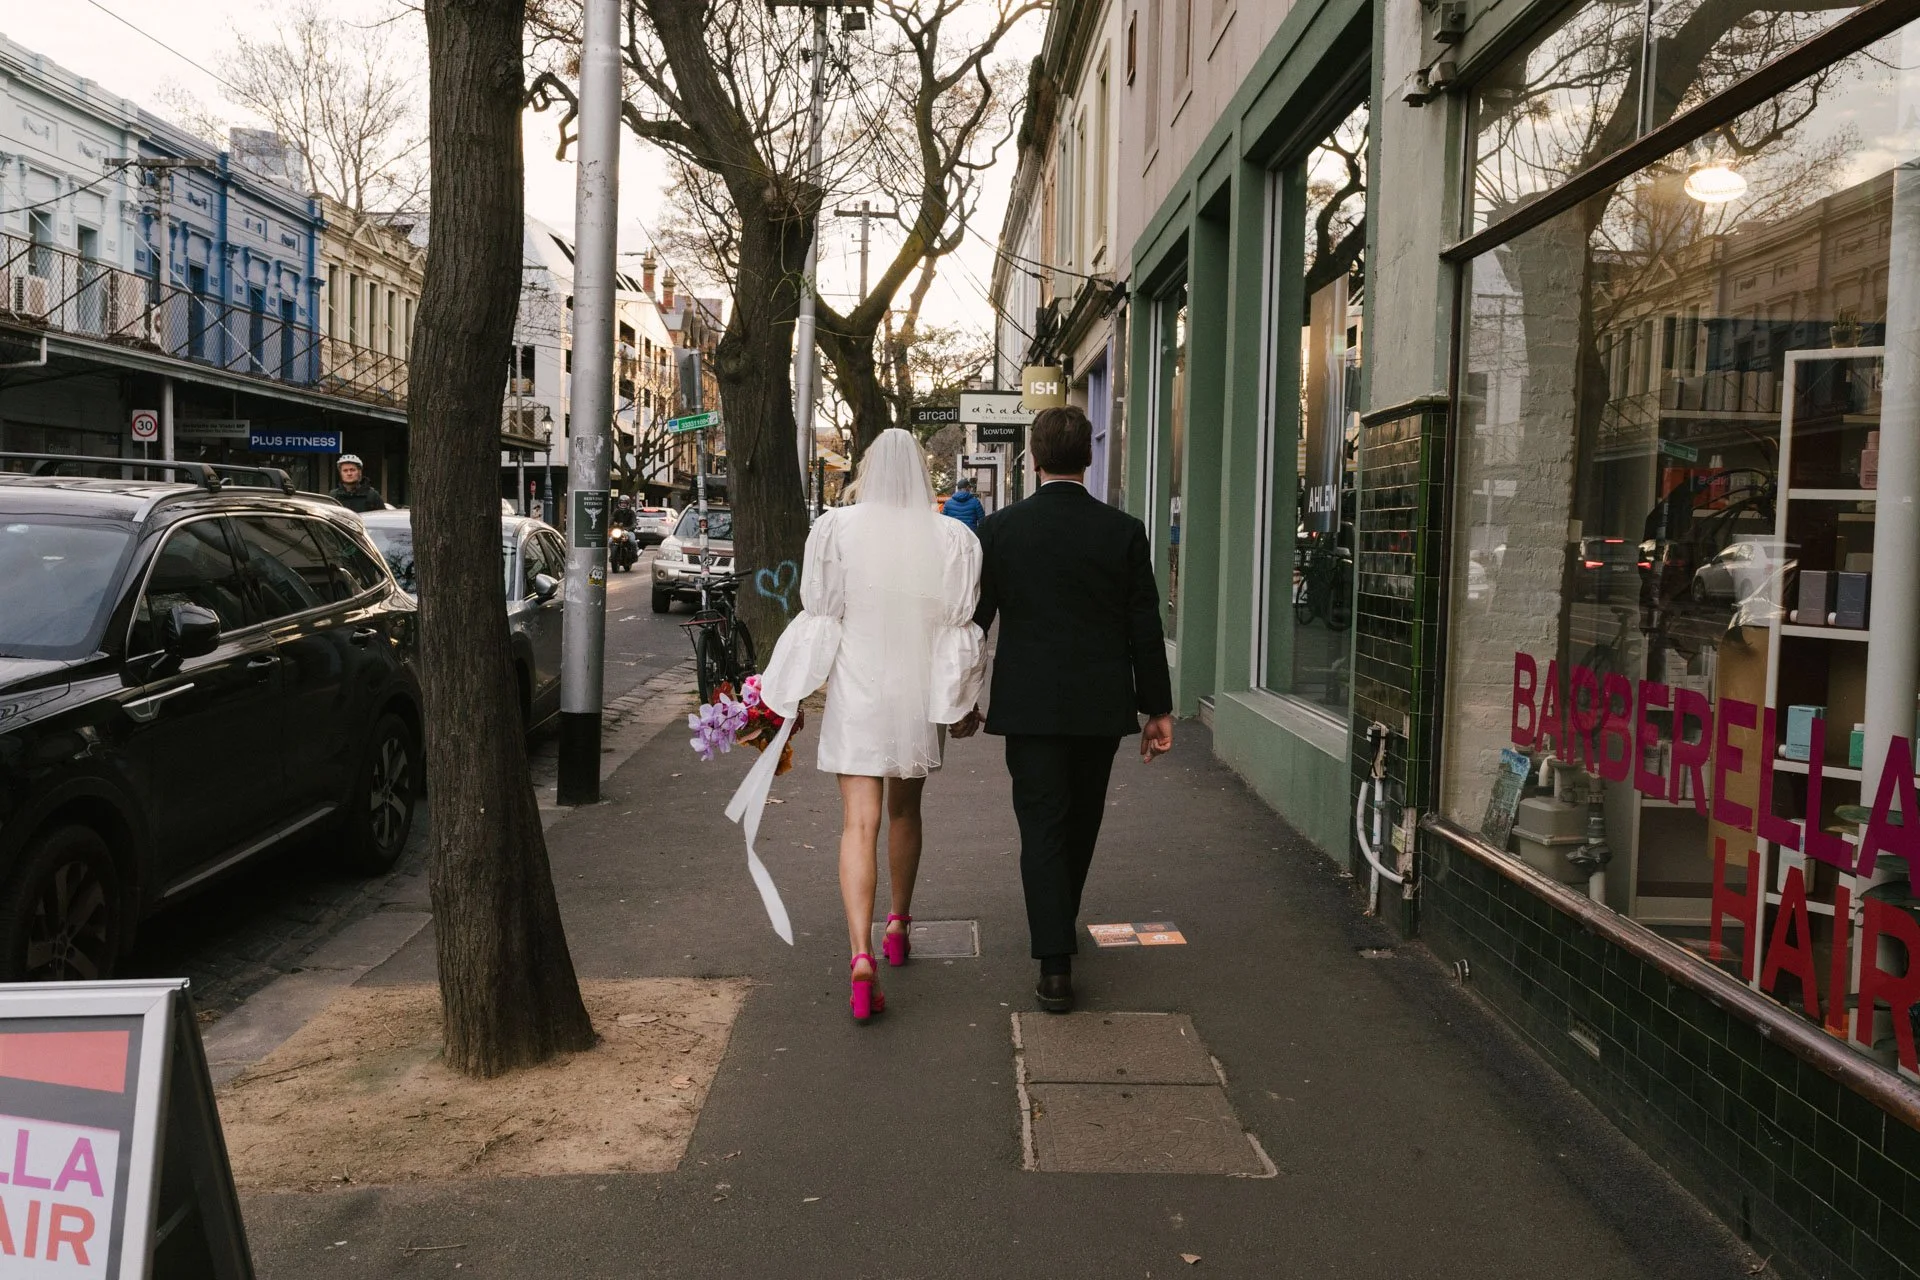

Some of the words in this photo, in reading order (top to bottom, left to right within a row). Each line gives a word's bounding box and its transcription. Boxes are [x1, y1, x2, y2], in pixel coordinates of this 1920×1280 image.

[1030, 381, 1057, 395] ISH
[918, 410, 958, 421] arcadi
[137, 420, 153, 431] 30
[983, 427, 1015, 435] kowtow
[252, 436, 283, 446] PLUS
[285, 437, 336, 447] FITNESS
[1308, 484, 1337, 513] AHLEM
[1510, 651, 1920, 899] BARBERELLA
[1709, 836, 1920, 1076] HAIR
[0, 1129, 104, 1198] LA
